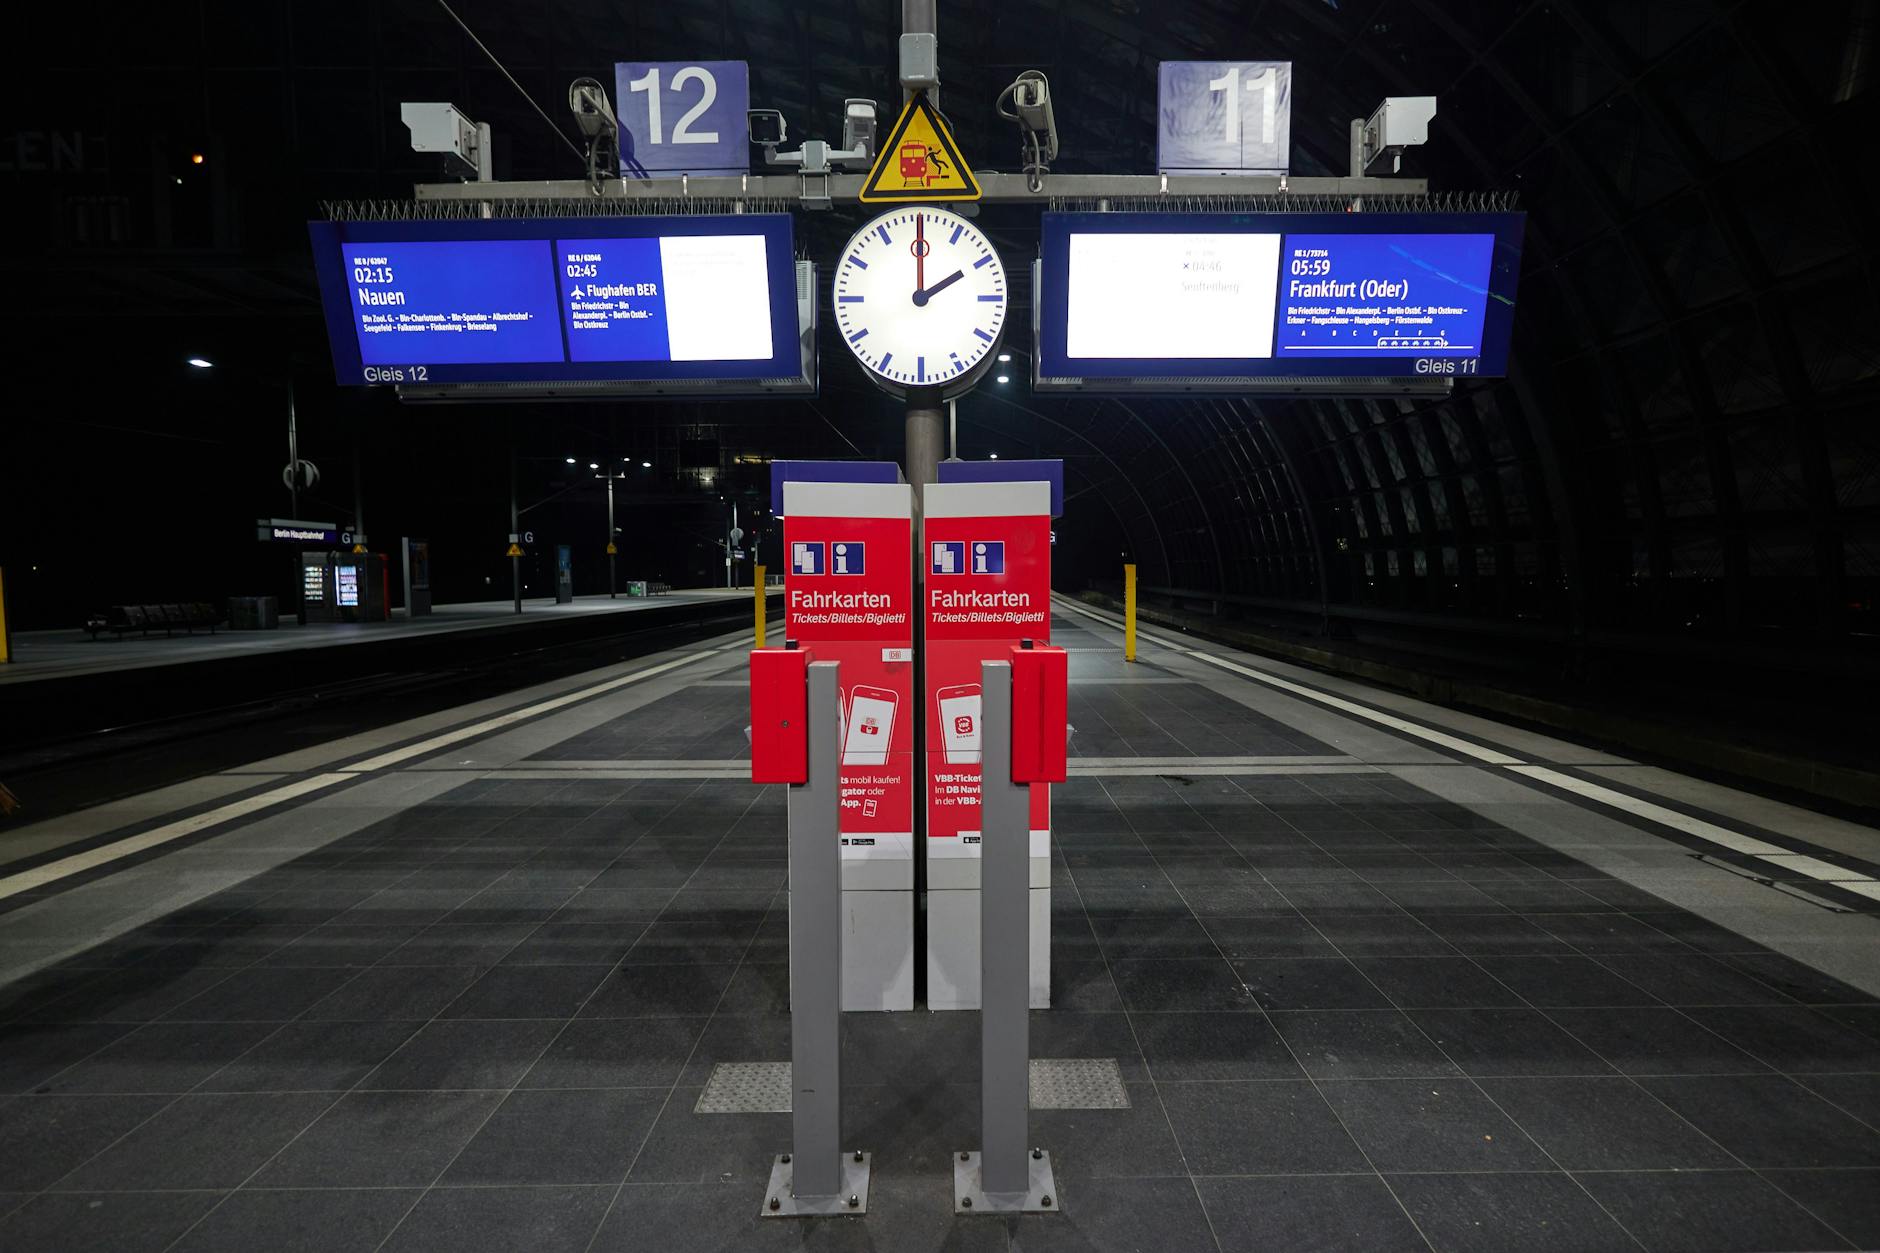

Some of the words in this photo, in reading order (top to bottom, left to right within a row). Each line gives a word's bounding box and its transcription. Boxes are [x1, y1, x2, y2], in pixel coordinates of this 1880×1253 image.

[631, 68, 719, 144] 12
[1209, 68, 1276, 144] 11
[567, 265, 597, 278] 02:45
[1292, 259, 1330, 275] 05:59
[355, 268, 393, 283] 02:15
[587, 284, 635, 299] Flughafen
[637, 283, 657, 296] BER
[1290, 280, 1356, 297] Frankfurt
[1360, 279, 1408, 300] (Oder)
[359, 288, 405, 305] Nauen
[387, 314, 394, 322] G.
[493, 312, 528, 320] Albrechtshof
[613, 311, 630, 319] Berlin
[1387, 307, 1404, 315] Berlin
[397, 323, 425, 331] Falkensee
[467, 323, 497, 331] Brieselang
[1301, 329, 1306, 337] A
[1331, 329, 1337, 337] B
[1352, 329, 1358, 337] C
[1372, 329, 1378, 337] D
[1394, 329, 1400, 337] E
[1417, 329, 1423, 337] F
[1440, 329, 1446, 337] G
[1415, 359, 1454, 373] Gleis
[1462, 359, 1476, 373] 11
[364, 367, 403, 381] Gleis
[409, 367, 428, 380] 12
[274, 529, 290, 538] Berlin
[290, 530, 324, 541] Hauptbahnhof
[342, 532, 351, 544] G
[525, 532, 534, 543] G
[791, 590, 891, 608] Fahrkarten
[931, 590, 1030, 608] Fahrkarten
[792, 613, 906, 625] Tickets/Billets/Biglietti
[932, 612, 1045, 624] Tickets/Billets/Biglietti
[850, 776, 872, 784] mobil
[873, 775, 901, 784] kaufen!
[867, 787, 885, 795] oder
[946, 785, 960, 794] DB
[961, 785, 981, 794] Navi
[841, 798, 861, 808] App.
[935, 797, 942, 805] in
[943, 797, 956, 805] der
